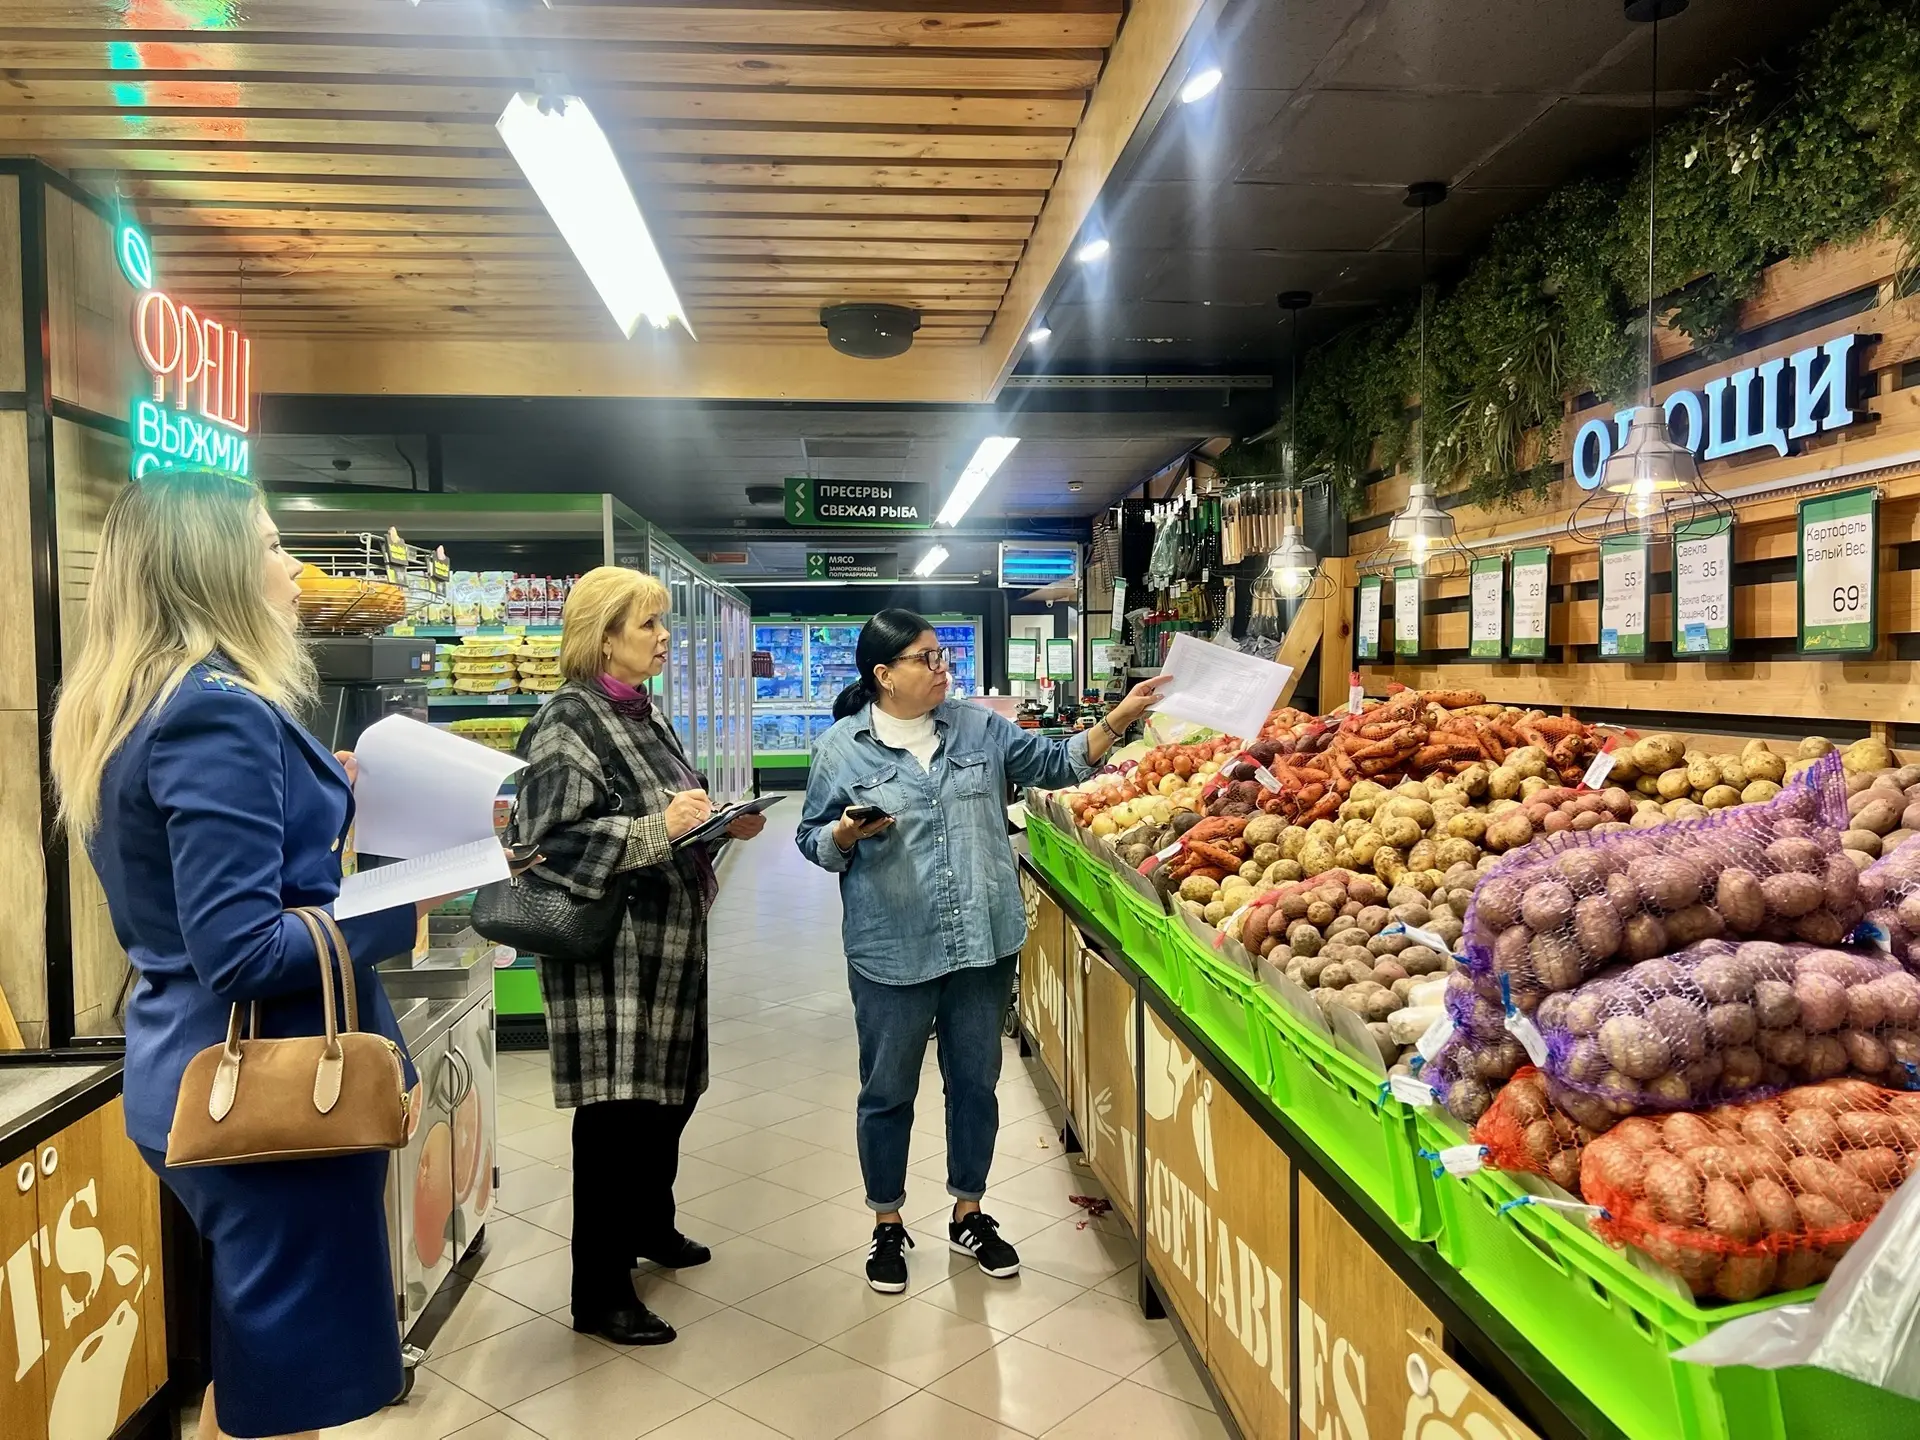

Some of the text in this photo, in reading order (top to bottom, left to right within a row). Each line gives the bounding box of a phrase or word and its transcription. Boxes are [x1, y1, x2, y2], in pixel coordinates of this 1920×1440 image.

[139, 291, 251, 433] ФРЕШ
[138, 401, 249, 476] ВЫЖМИ
[820, 485, 892, 499] ПРЕСЕРВЫ
[820, 504, 918, 519] СВЕЖАЯ РЫБА
[1806, 520, 1867, 542] Картофель
[1678, 544, 1707, 558] Свекла
[1807, 542, 1868, 562] Белый Вес.
[828, 556, 854, 564] МЯСО
[1702, 560, 1717, 577] 35
[1624, 572, 1637, 587] 55
[1529, 583, 1540, 596] 29
[1700, 594, 1715, 604] Фас
[1833, 585, 1859, 612] 69
[1625, 612, 1636, 628] 21
[1705, 604, 1718, 621] 18
[1531, 619, 1540, 632] 12
